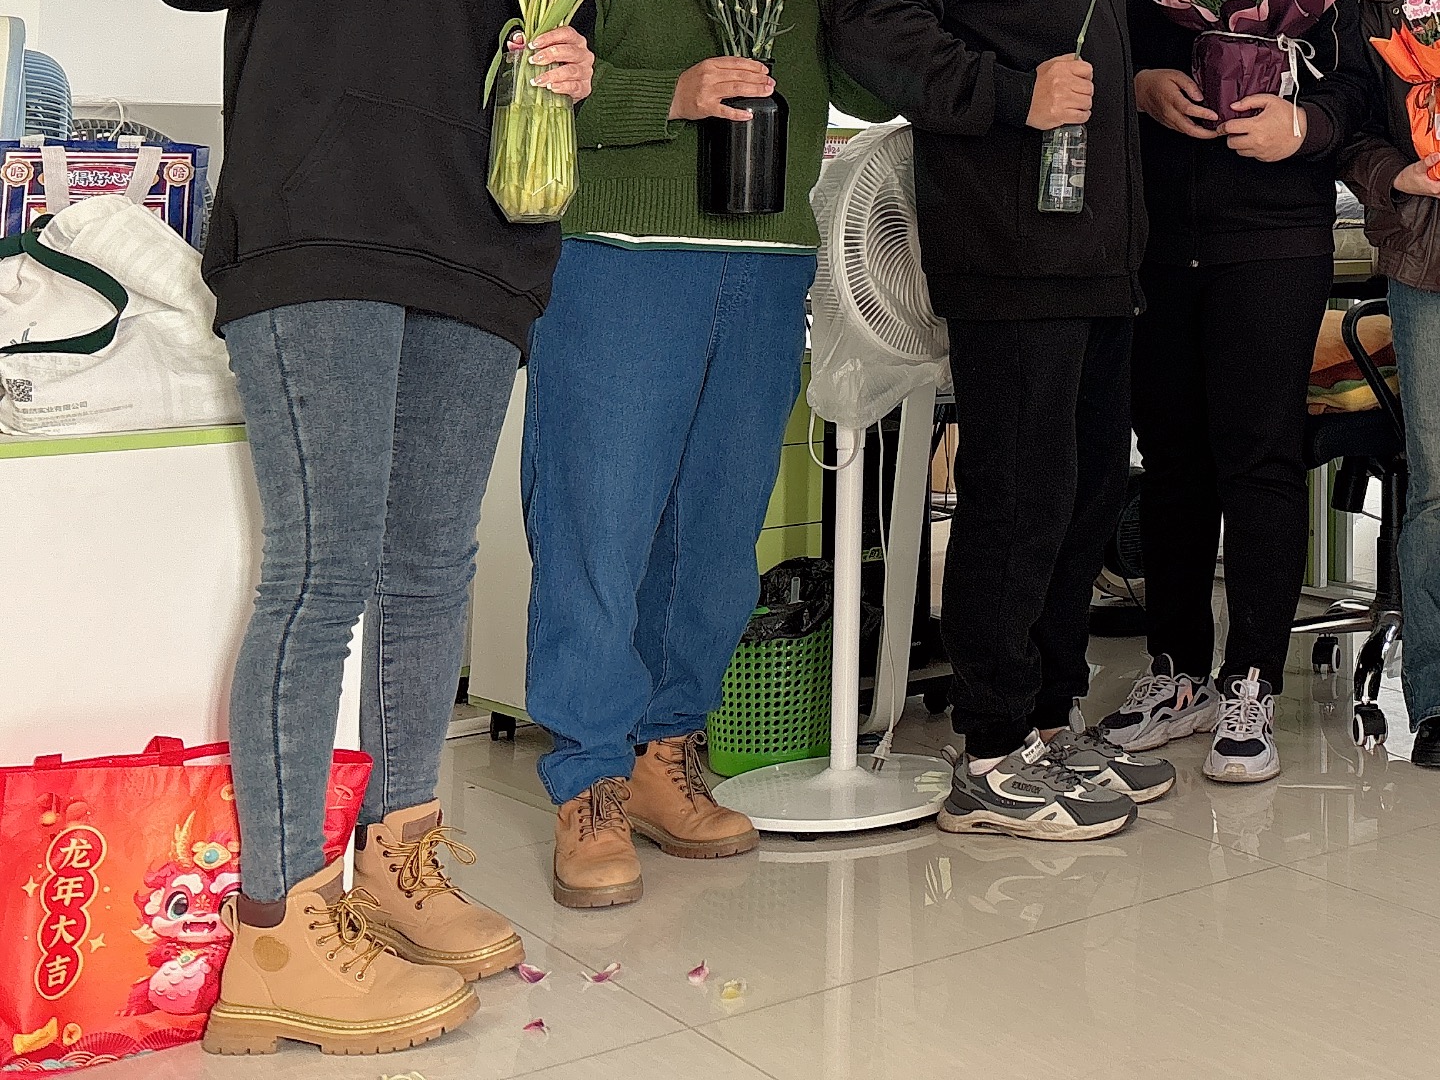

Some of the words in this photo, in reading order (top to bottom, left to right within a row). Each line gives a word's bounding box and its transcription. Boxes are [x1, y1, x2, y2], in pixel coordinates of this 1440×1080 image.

[10, 166, 24, 179] 哈
[68, 170, 132, 187] 得好心
[172, 166, 187, 179] 哈
[46, 837, 93, 988] 龙年大吉
